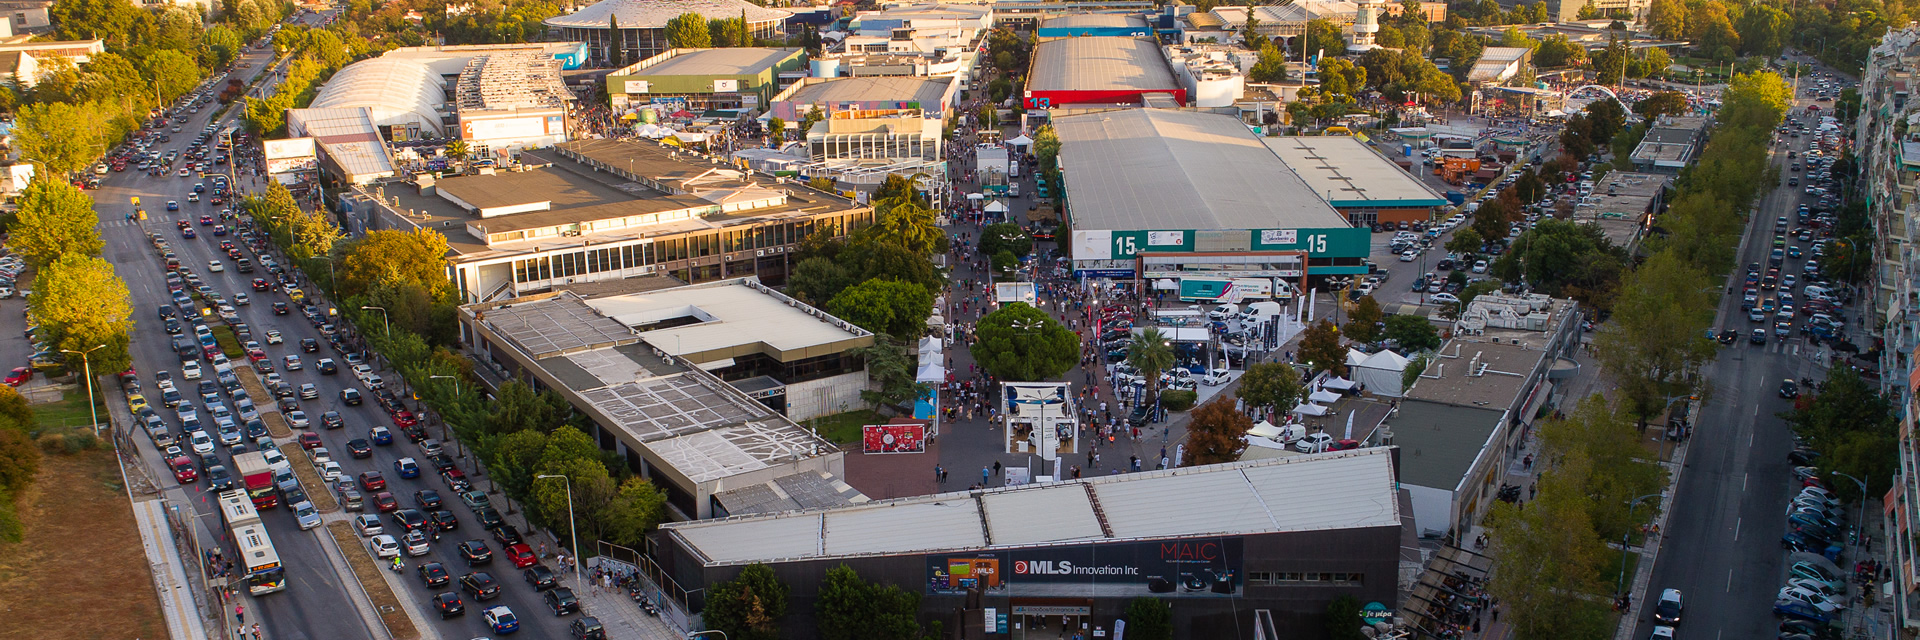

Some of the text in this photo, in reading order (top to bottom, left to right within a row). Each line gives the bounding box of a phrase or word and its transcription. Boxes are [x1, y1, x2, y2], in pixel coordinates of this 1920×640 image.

[567, 55, 574, 66] 3
[737, 79, 750, 91] 16
[1029, 97, 1050, 108] 13
[407, 127, 420, 139] 17
[465, 122, 473, 133] 2
[1116, 236, 1136, 255] 15
[1307, 234, 1327, 253] 15
[1160, 542, 1217, 560] MAIC
[977, 567, 995, 575] MLS
[1030, 560, 1139, 575] MLS Innovation Inc
